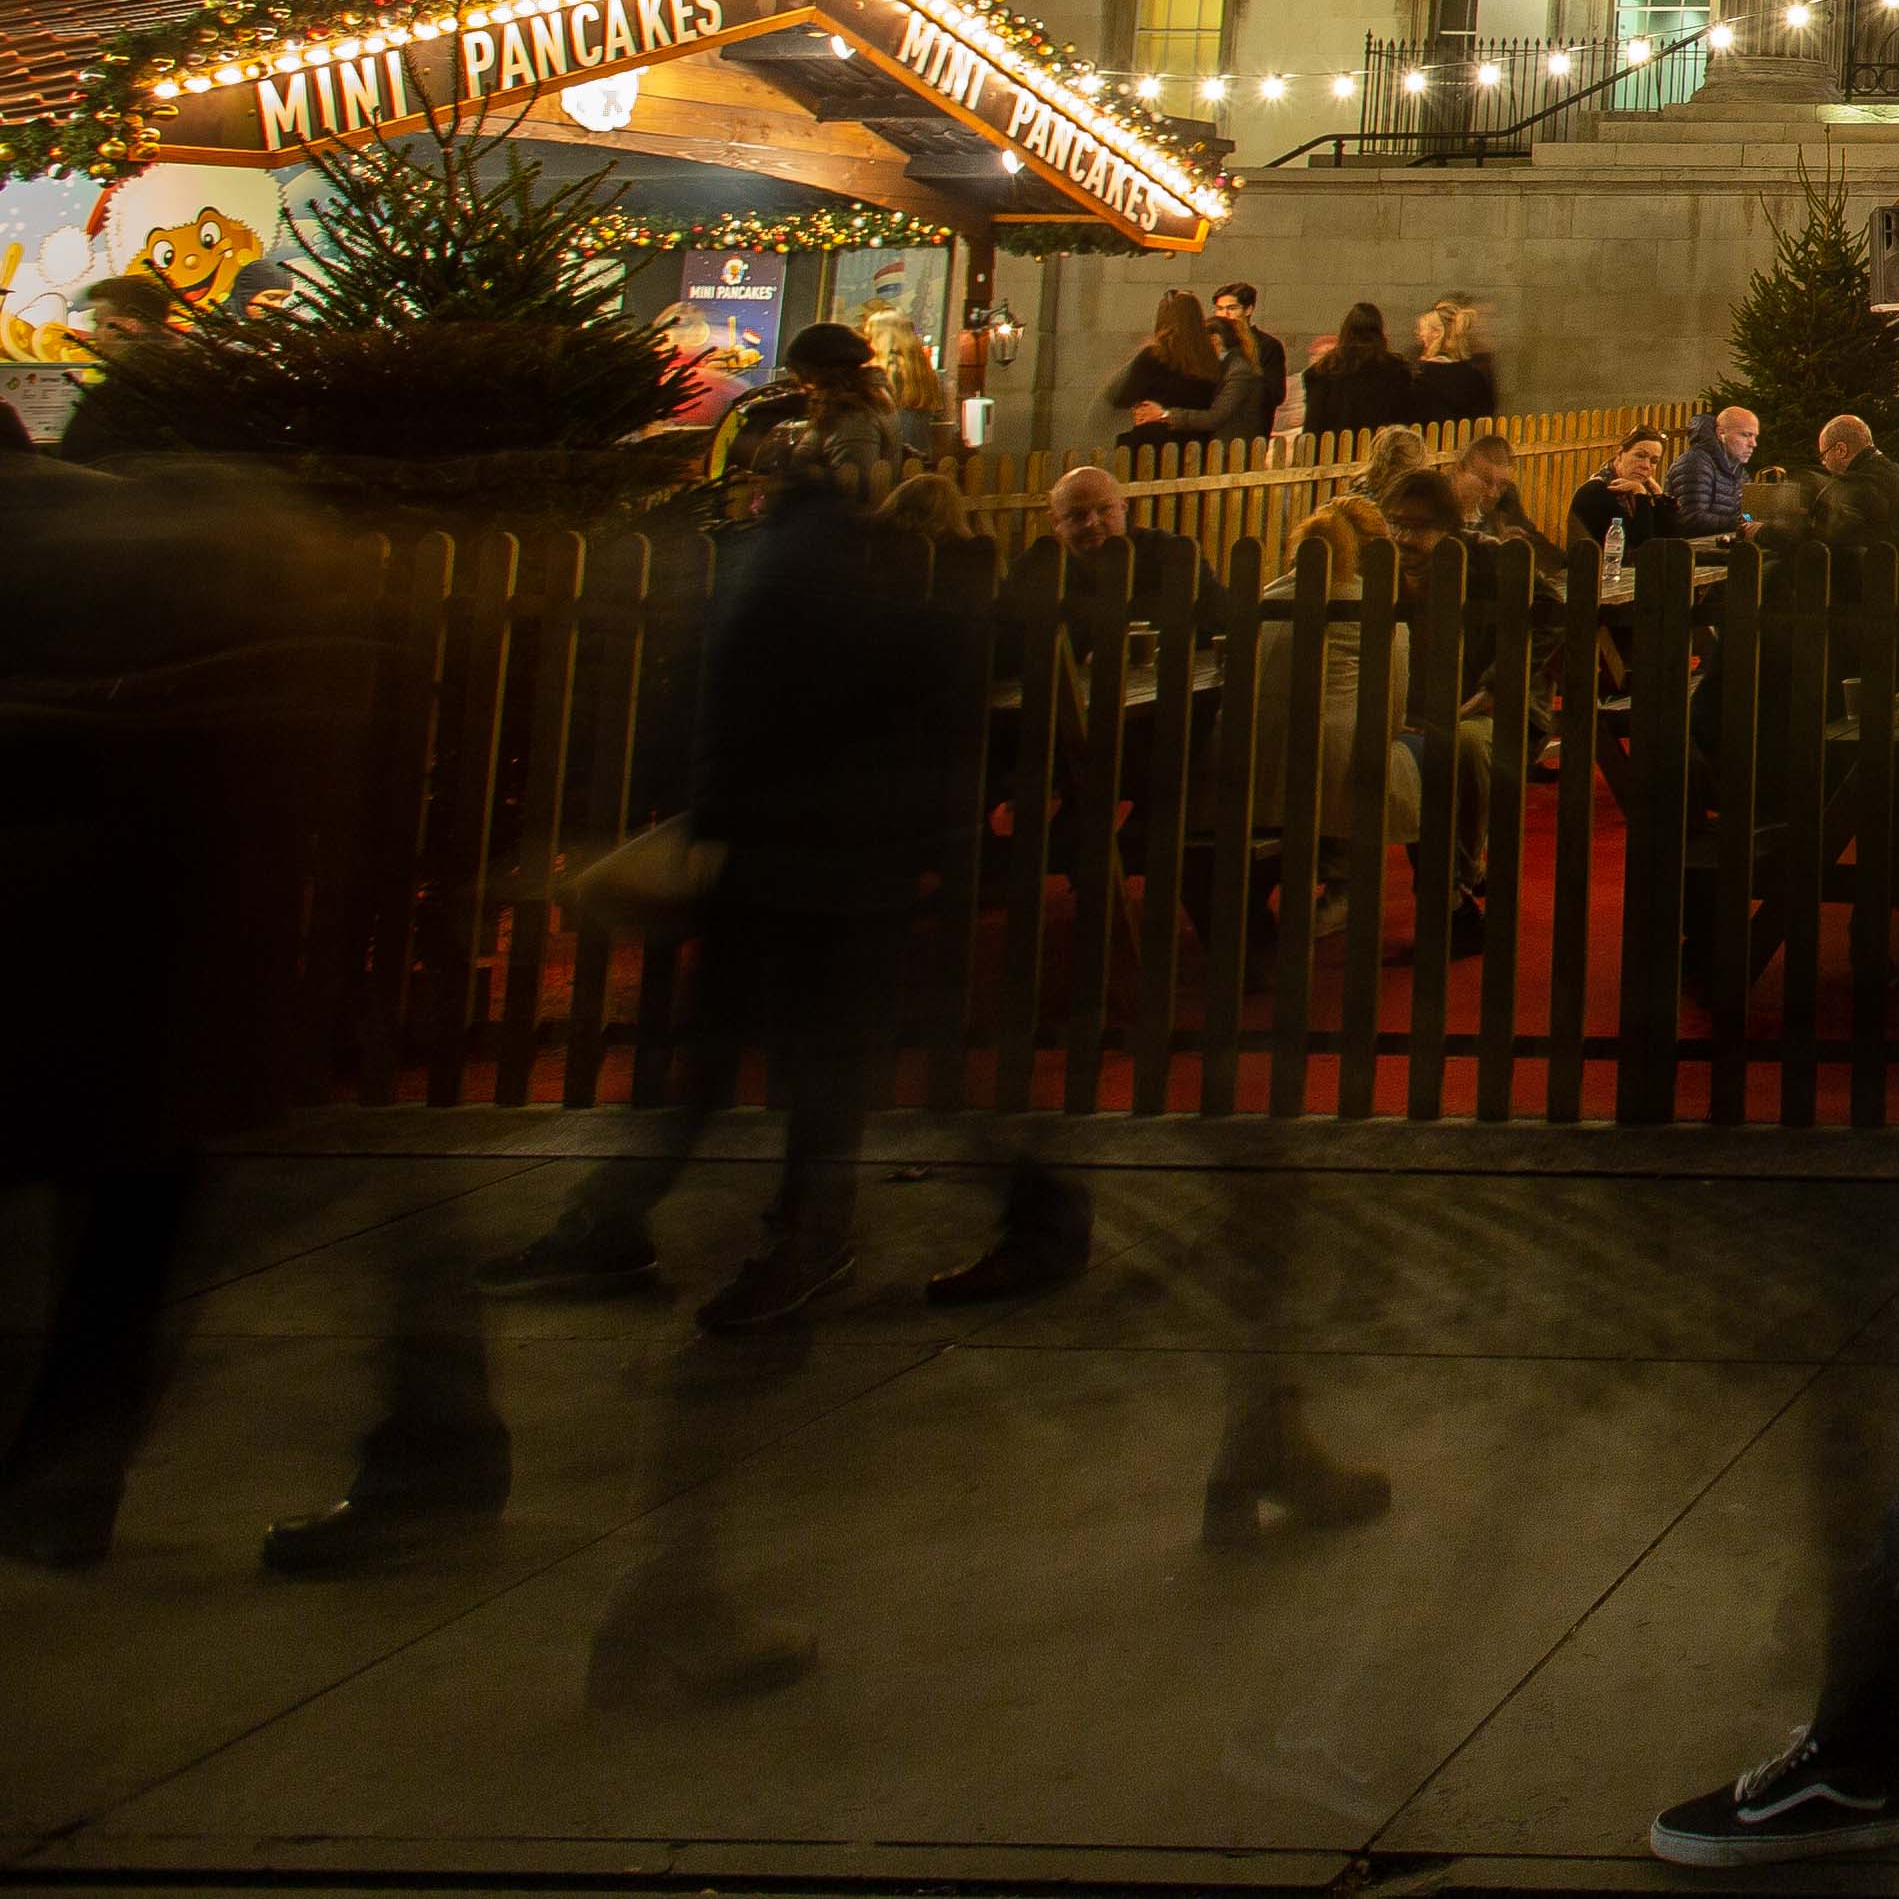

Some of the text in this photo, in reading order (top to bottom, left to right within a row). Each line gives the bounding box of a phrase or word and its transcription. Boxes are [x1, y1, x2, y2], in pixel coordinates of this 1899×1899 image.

[257, 50, 408, 151] MINI
[896, 10, 1159, 231] MINI PANCAKES
[690, 286, 715, 299] MINI
